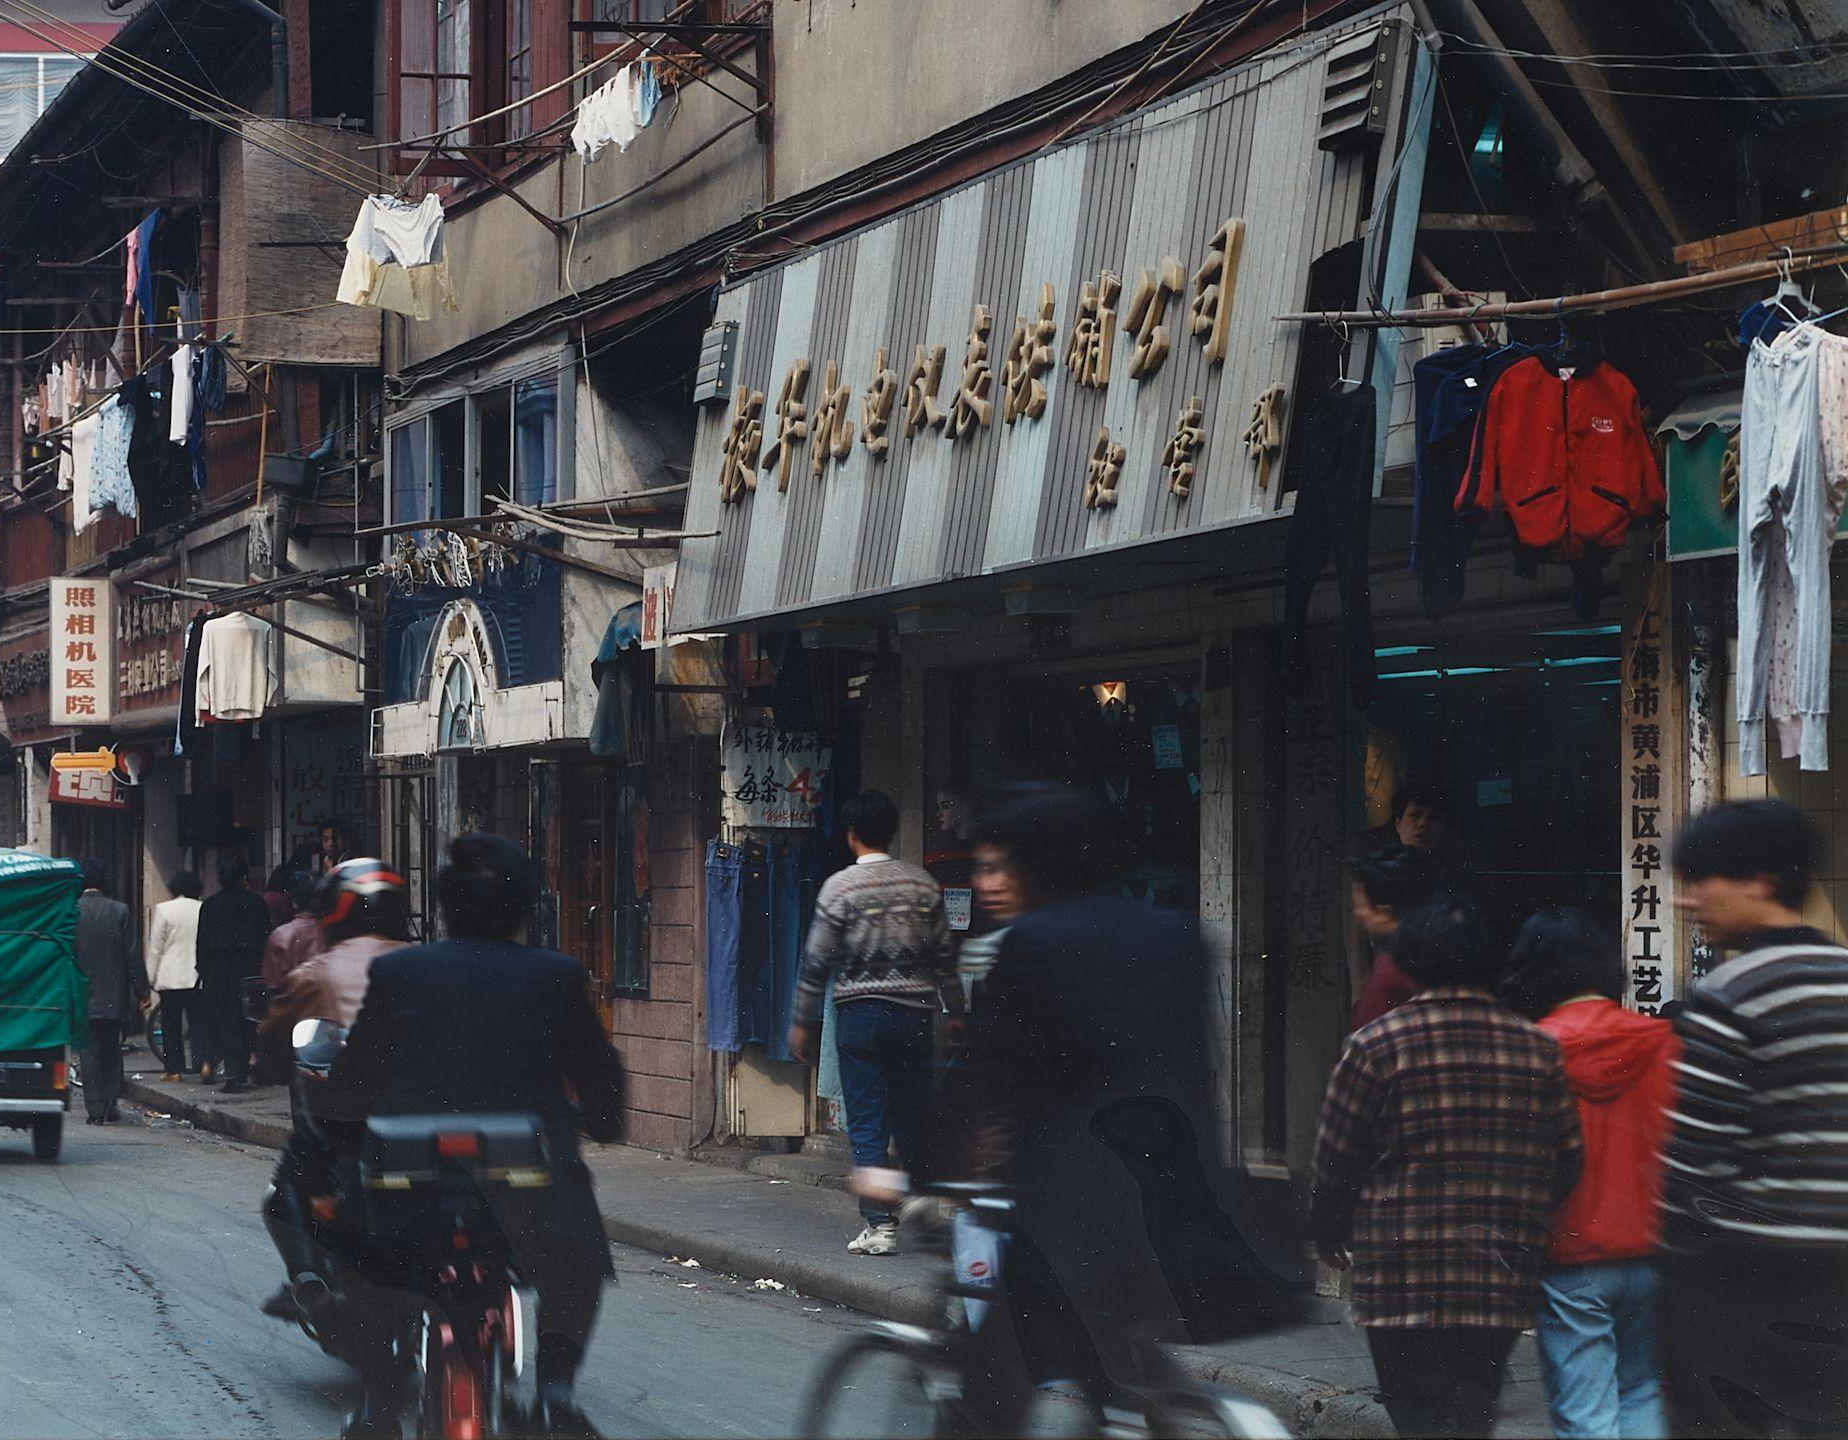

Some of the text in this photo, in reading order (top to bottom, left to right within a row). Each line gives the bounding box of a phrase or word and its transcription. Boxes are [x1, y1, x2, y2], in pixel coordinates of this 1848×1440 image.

[64, 586, 97, 716] 照相机医院
